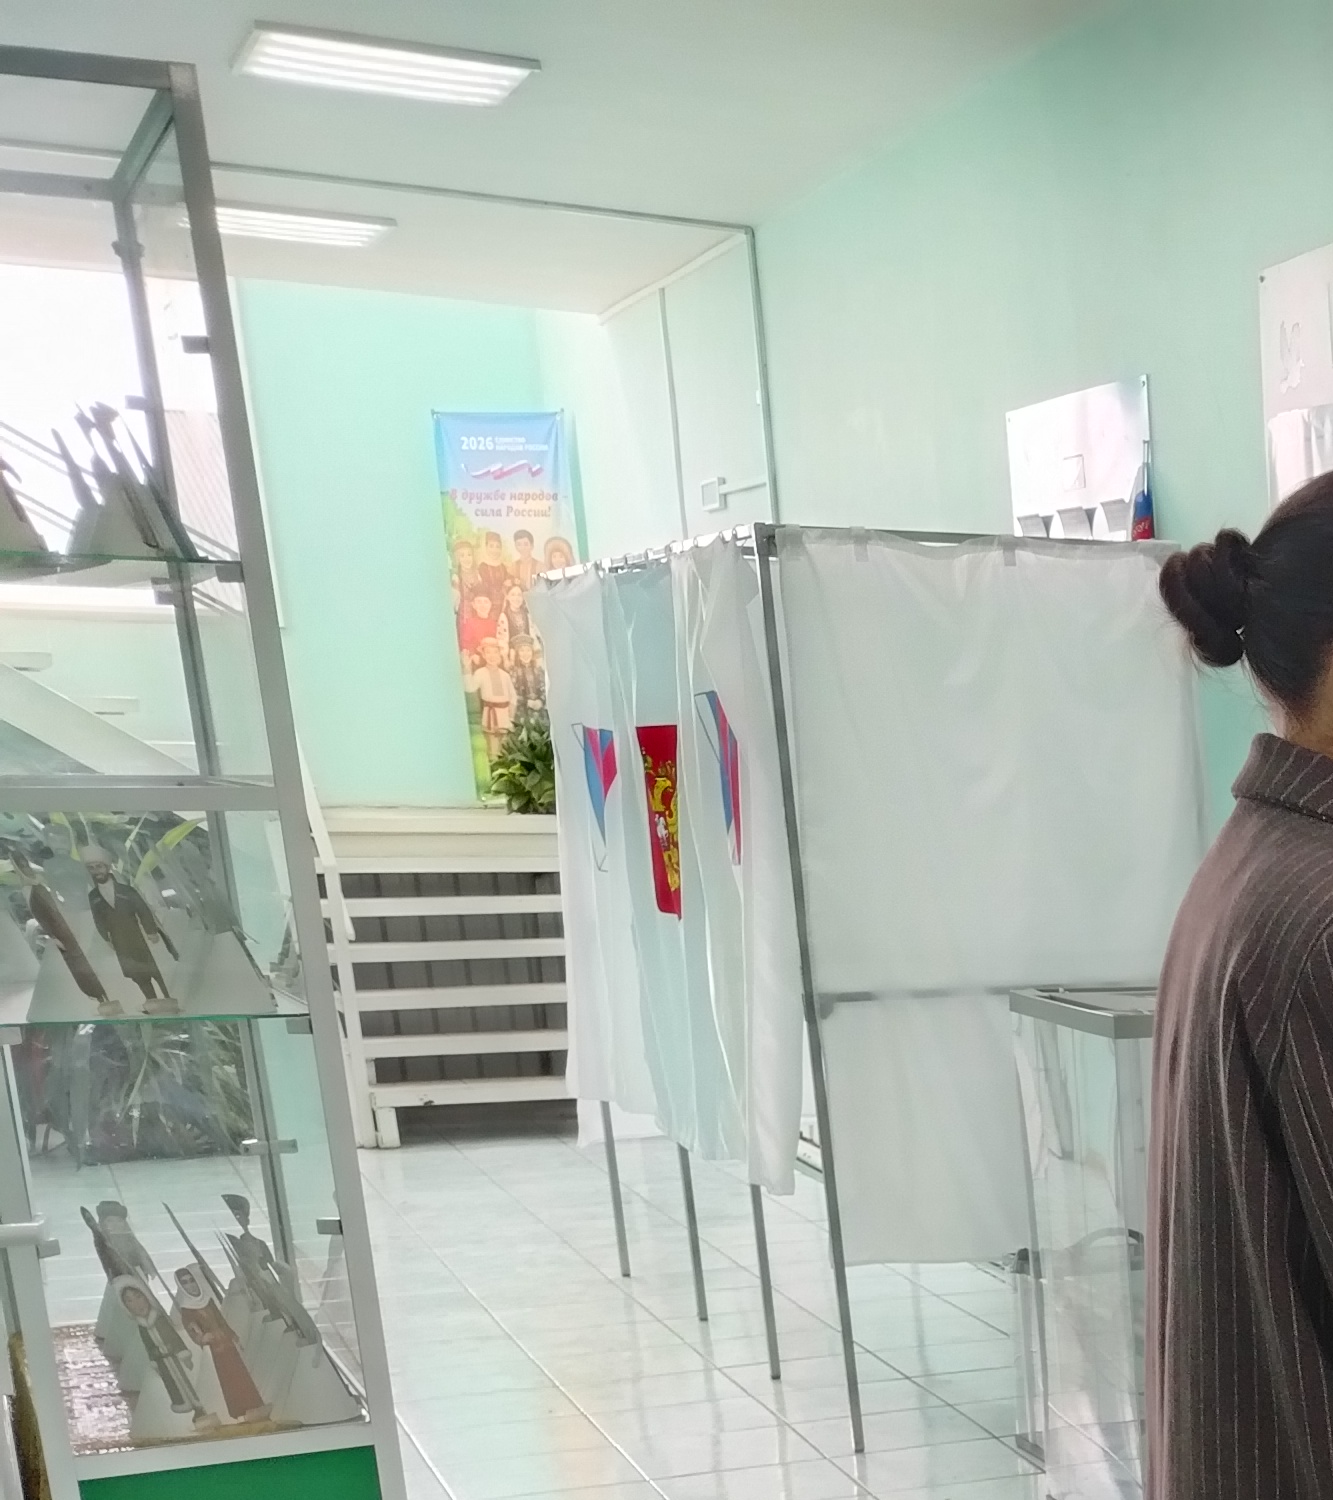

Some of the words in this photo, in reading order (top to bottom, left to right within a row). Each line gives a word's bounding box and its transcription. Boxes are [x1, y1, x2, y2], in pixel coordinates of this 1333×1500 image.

[460, 436, 494, 450] 2026
[461, 489, 506, 504] дружбе
[510, 489, 558, 504] народов
[474, 508, 502, 517] сила
[506, 506, 551, 518] России!
